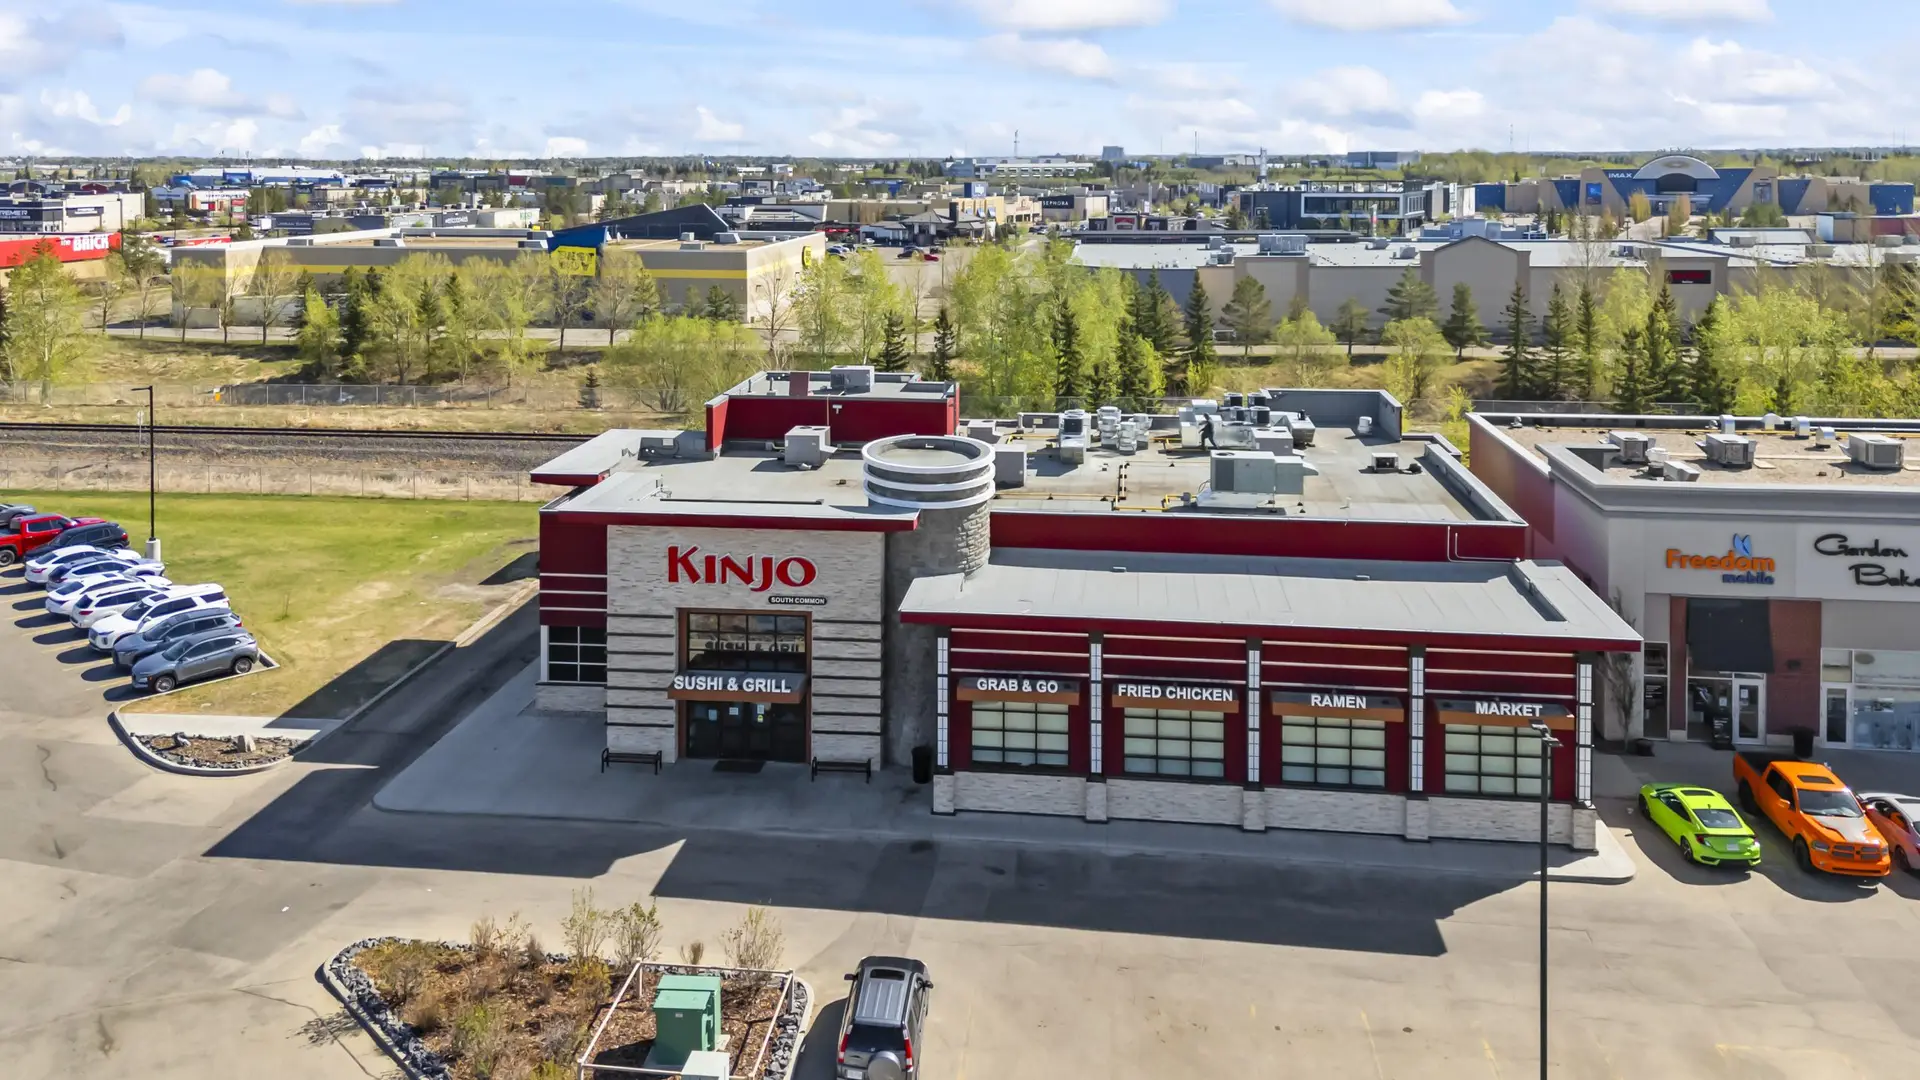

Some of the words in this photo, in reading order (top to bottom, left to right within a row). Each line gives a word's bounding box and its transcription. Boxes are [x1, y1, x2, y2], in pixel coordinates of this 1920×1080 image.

[73, 235, 109, 251] BRICK
[1814, 533, 1909, 558] Garden
[1666, 548, 1776, 572] Freedom
[1722, 571, 1775, 585] mobile
[674, 675, 723, 691] SUSHI
[726, 677, 739, 692] &
[742, 678, 792, 693] GRILL
[976, 678, 1020, 692] GRAB
[1022, 679, 1033, 692] &
[1035, 680, 1059, 693] GO
[1117, 684, 1162, 700] FRIED
[1164, 685, 1234, 702] CHICKEN
[1310, 693, 1368, 709] RAMEN
[1475, 701, 1543, 718] MARKET
